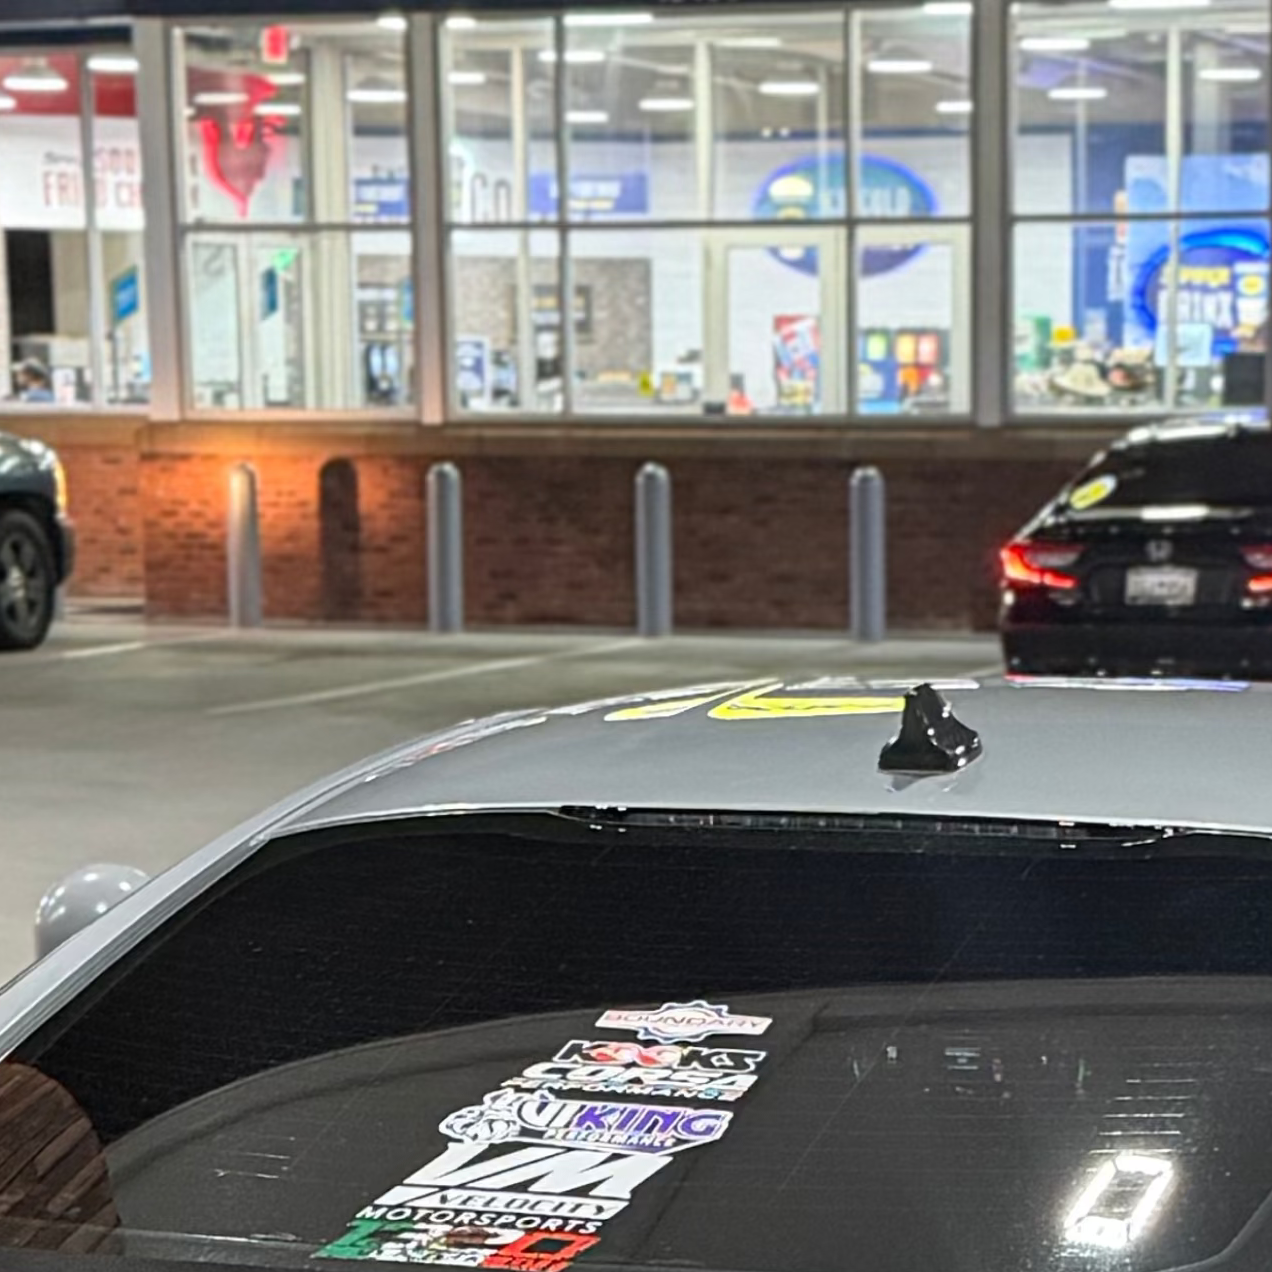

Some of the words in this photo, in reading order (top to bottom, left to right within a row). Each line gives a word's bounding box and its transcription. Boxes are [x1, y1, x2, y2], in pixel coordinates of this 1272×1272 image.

[523, 1062, 758, 1091] CORSA
[516, 1097, 725, 1138] VIKING
[542, 1128, 678, 1147] PERFORMANCE
[403, 1142, 673, 1199] VM
[355, 1205, 604, 1234] MOTORSPORTS
[439, 1193, 618, 1217] VELOCITY
